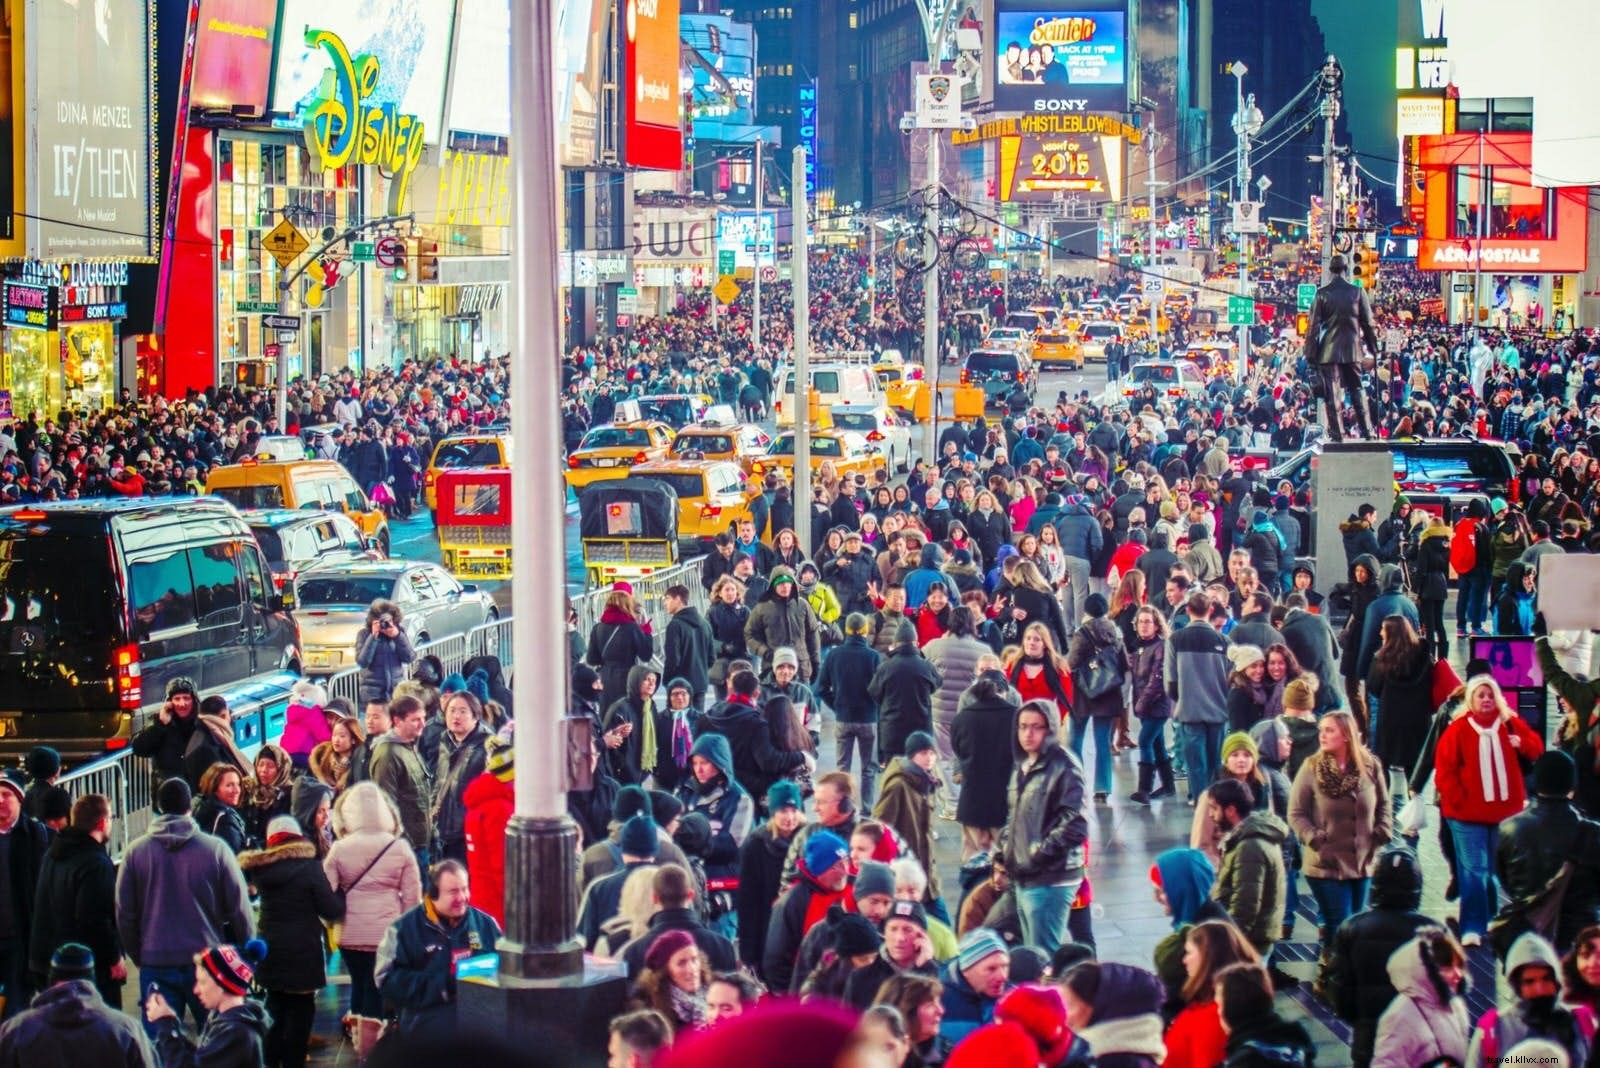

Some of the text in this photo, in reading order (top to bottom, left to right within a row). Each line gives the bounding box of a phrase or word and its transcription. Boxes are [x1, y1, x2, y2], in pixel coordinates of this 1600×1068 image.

[1031, 17, 1096, 42] Seinfeld
[57, 101, 132, 129] IDINA MENZEL
[1034, 99, 1088, 111] SONY
[53, 137, 138, 206] IF/THEN
[22, 260, 129, 286] GIFTS LUGGAGE
[1145, 280, 1162, 291] 25
[87, 305, 108, 319] SONY
